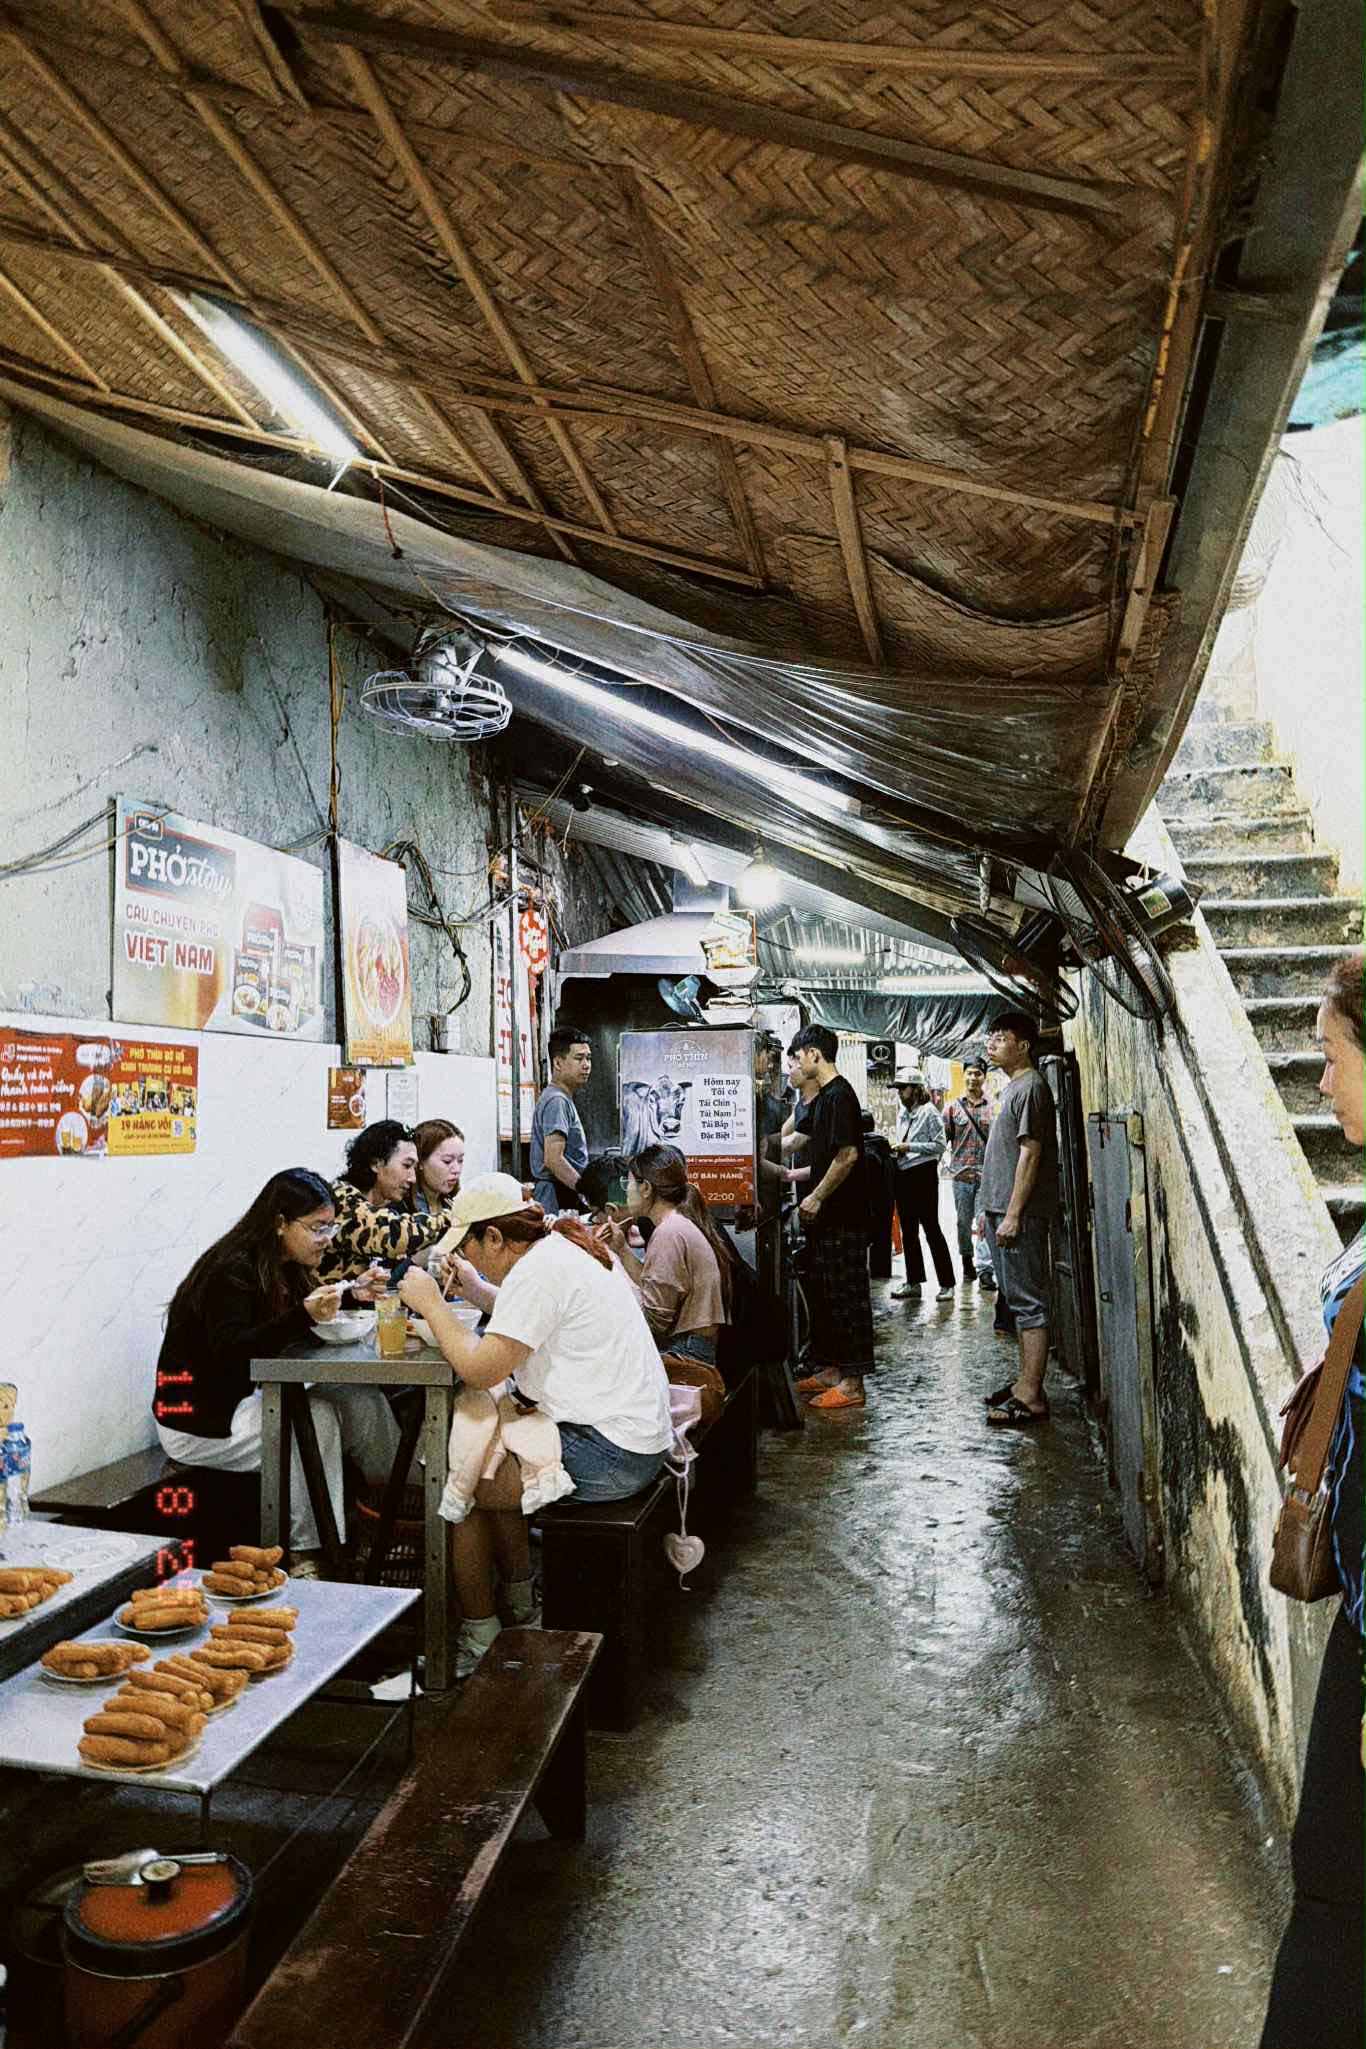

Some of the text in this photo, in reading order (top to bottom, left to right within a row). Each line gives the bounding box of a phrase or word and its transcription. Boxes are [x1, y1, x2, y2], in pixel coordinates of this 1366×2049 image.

[175, 942, 214, 972] NAM
[704, 1078, 741, 1088] Hôm nay
[711, 1086, 738, 1096] Tôi có
[699, 1099, 711, 1107] Tái
[708, 1192, 735, 1201] 22:00
